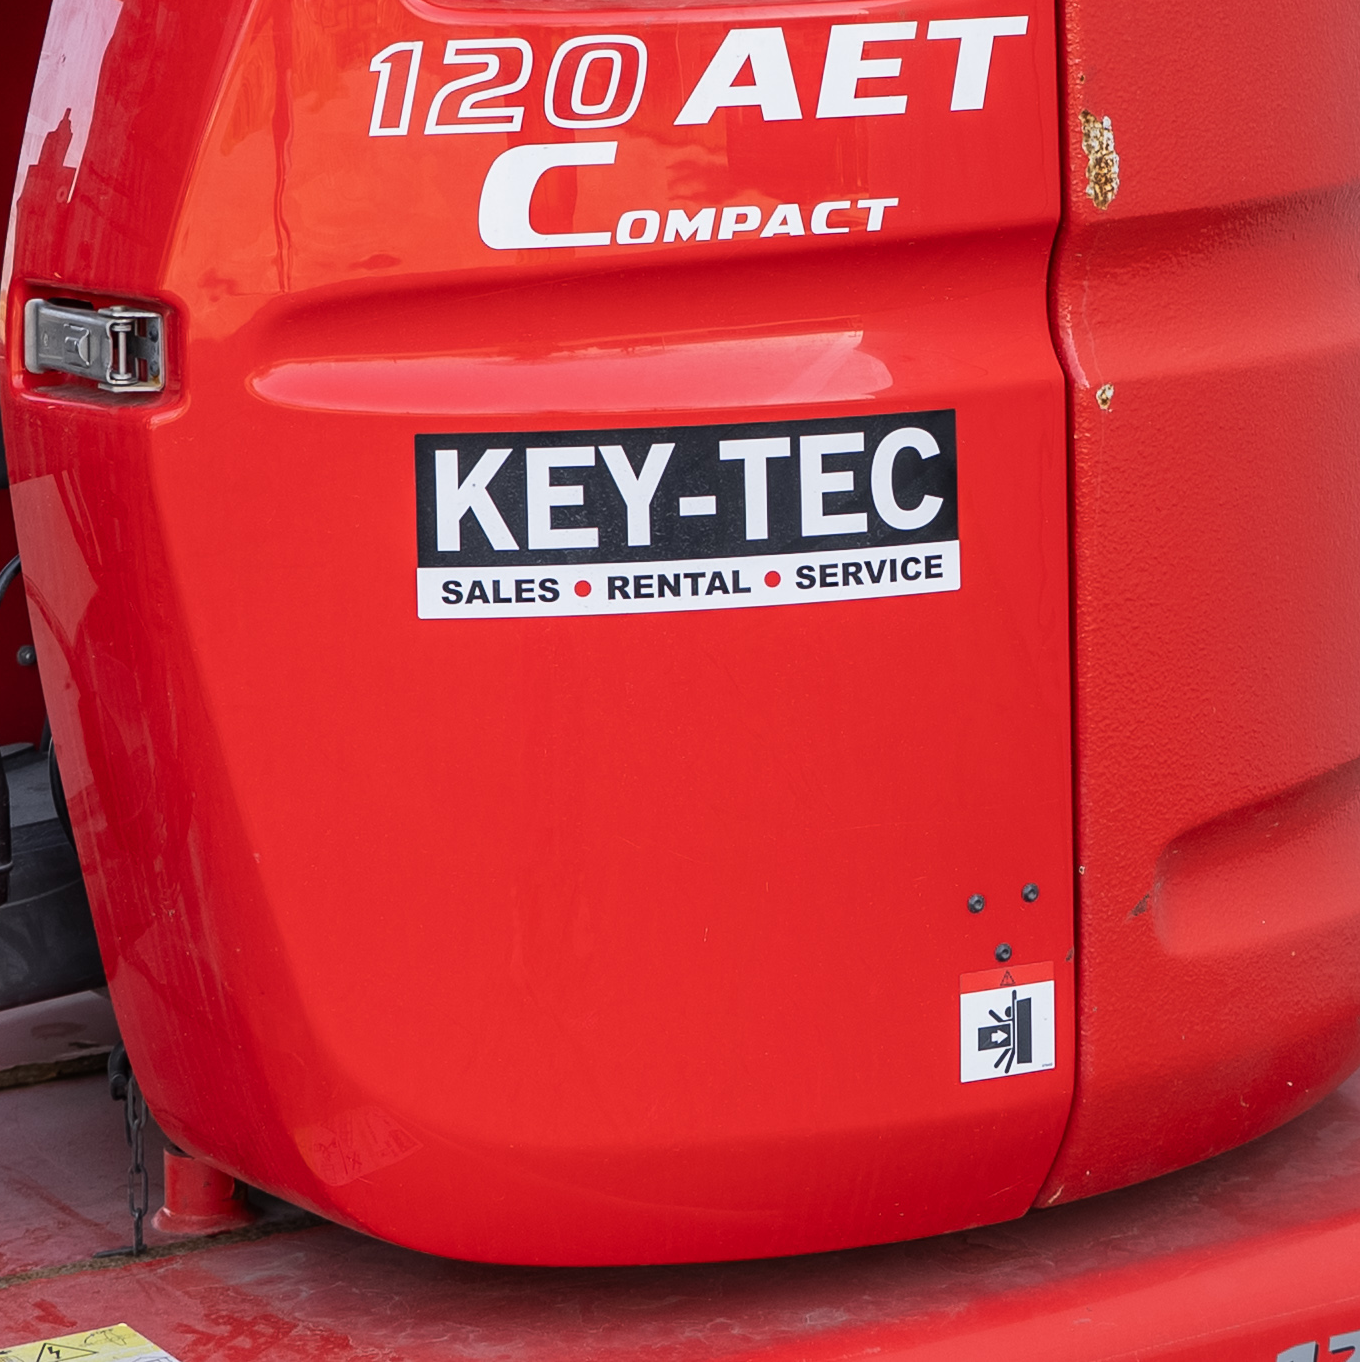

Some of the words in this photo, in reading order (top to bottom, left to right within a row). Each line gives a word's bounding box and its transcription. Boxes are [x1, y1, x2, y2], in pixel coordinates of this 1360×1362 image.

[367, 34, 648, 137] 120
[673, 15, 1030, 127] AET
[434, 426, 944, 552] KEY-TEC
[441, 577, 561, 605] SALES
[607, 569, 752, 600] RENTAL
[794, 554, 944, 590] SERVICE
